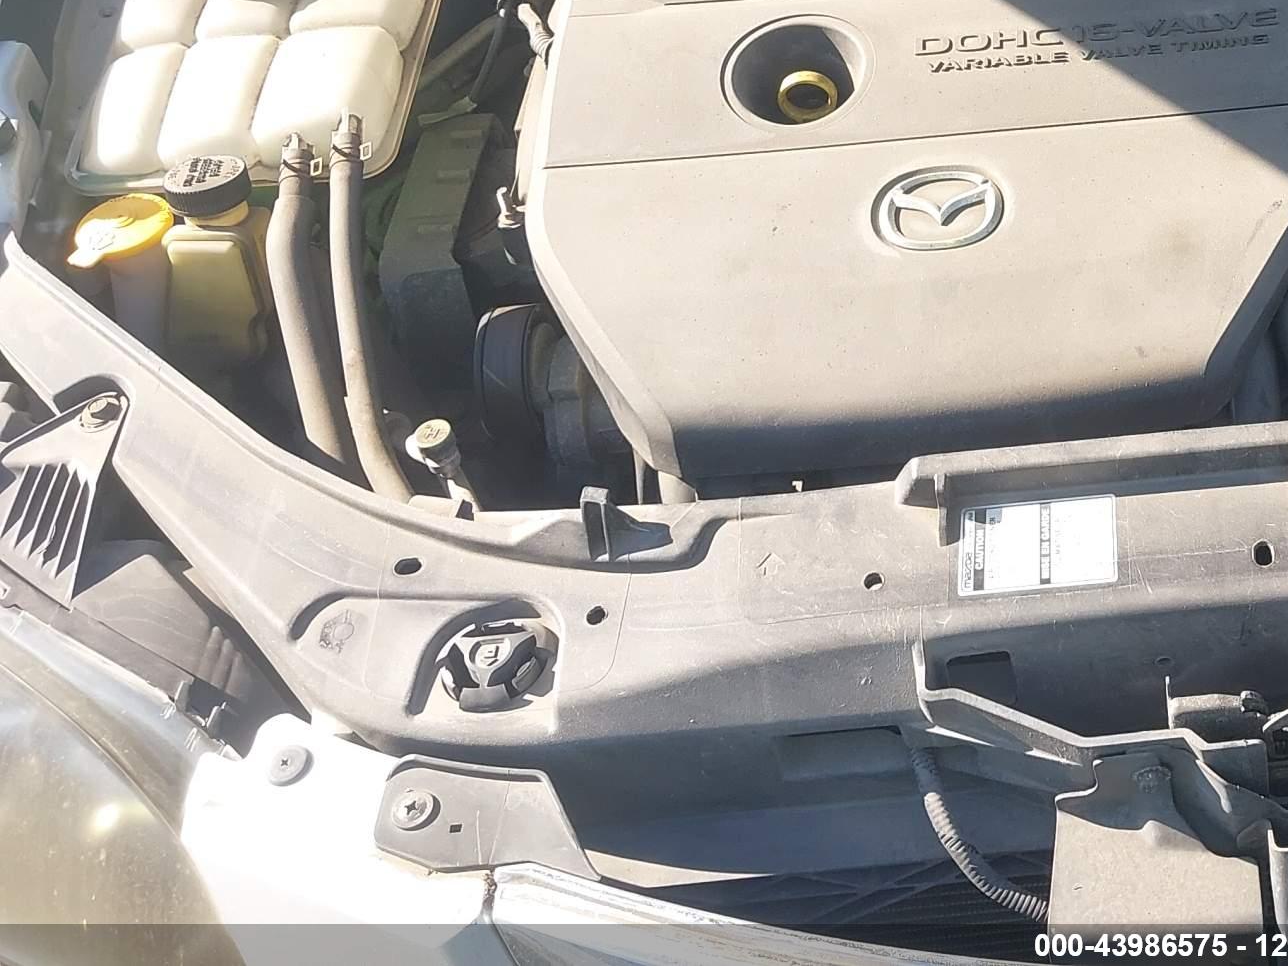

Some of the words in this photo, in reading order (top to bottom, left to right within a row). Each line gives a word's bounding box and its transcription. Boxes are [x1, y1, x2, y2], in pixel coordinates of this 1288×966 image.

[915, 28, 1064, 56] DOHC
[928, 51, 1070, 73] VARIABLE
[1081, 43, 1165, 61] VALVE
[1171, 33, 1271, 52] TIMING
[975, 529, 985, 570] CAUTION
